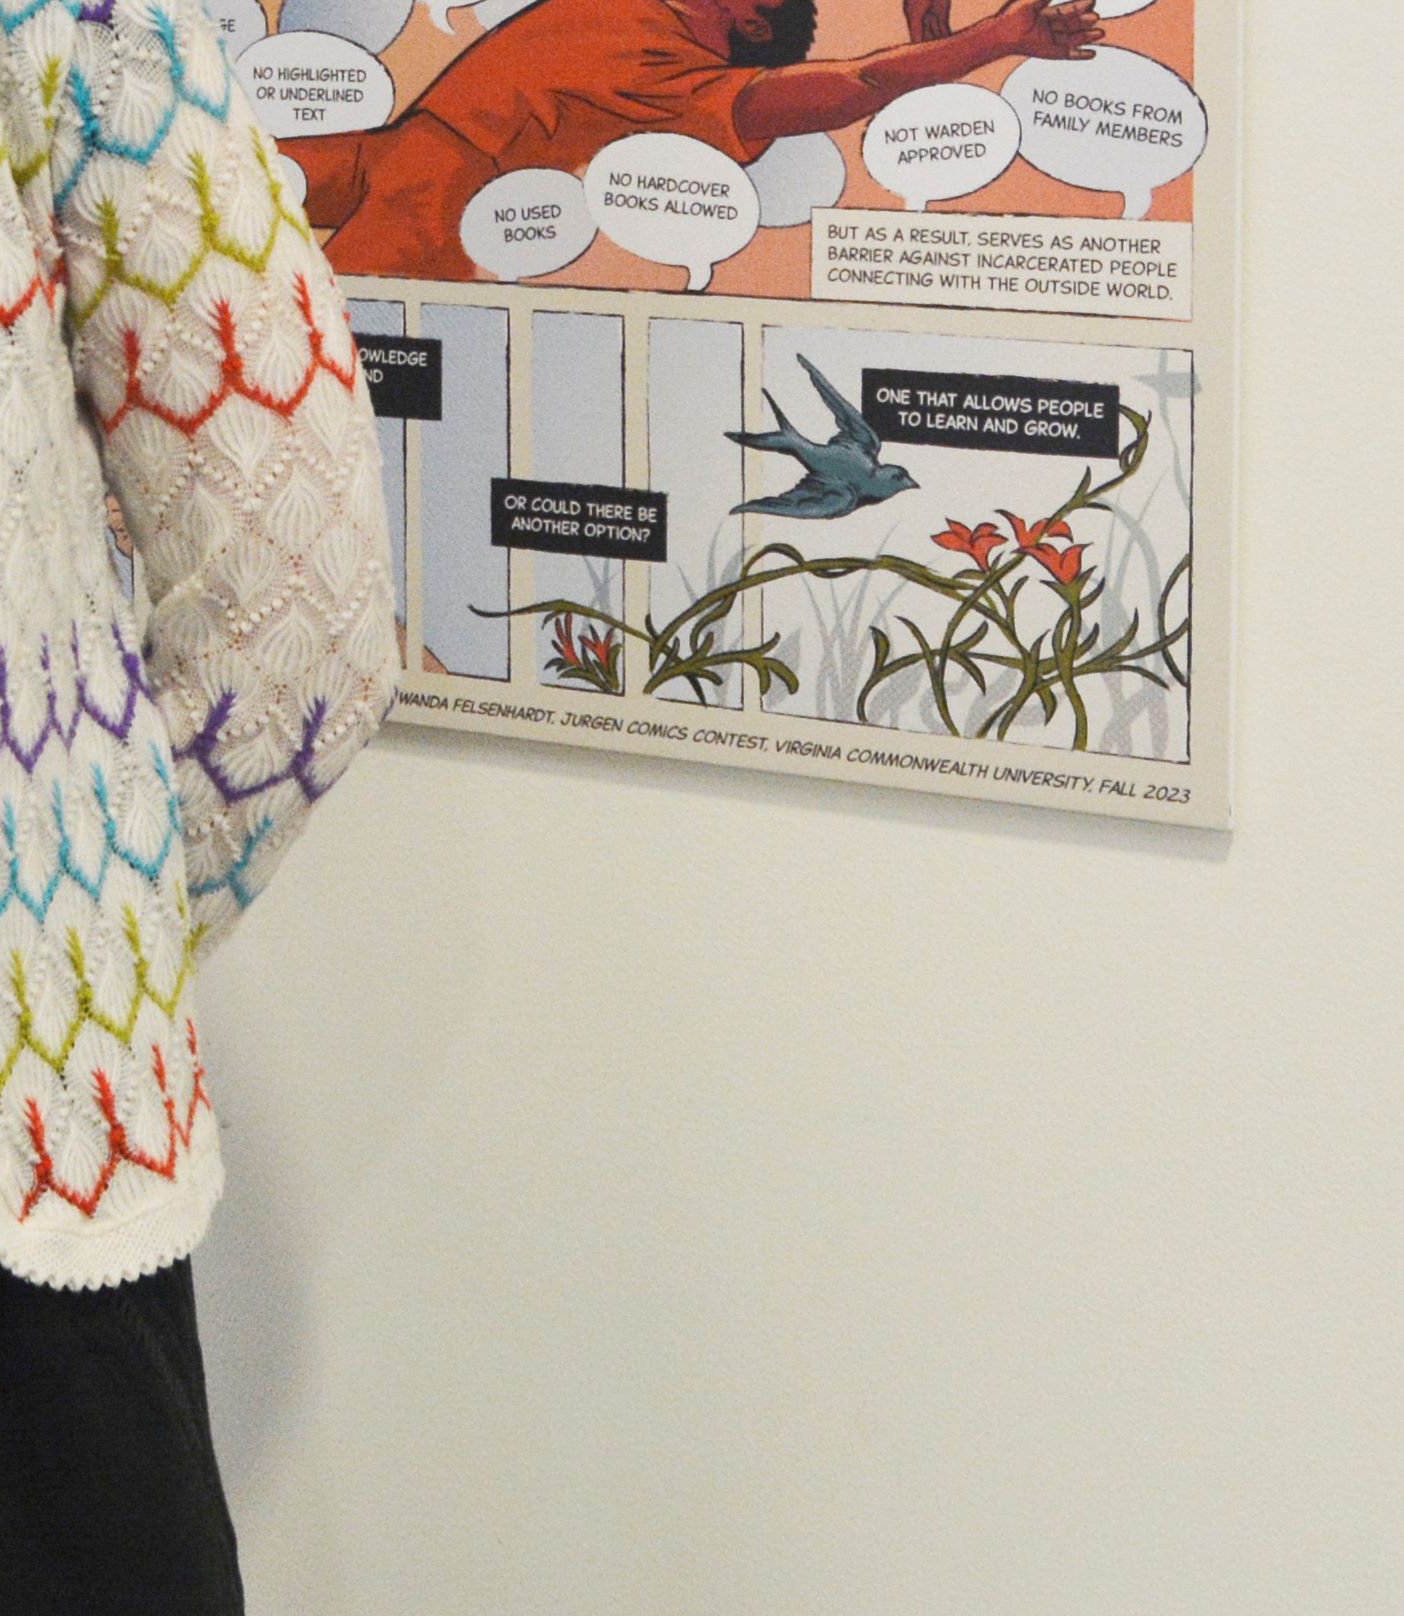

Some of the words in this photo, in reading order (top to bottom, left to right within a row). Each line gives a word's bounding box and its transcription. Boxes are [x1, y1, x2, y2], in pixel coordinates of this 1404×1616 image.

[252, 65, 274, 80] NO
[277, 66, 367, 83] HIGHLIGHTED
[255, 85, 276, 100] OR
[279, 86, 364, 103] UNDERLINED
[1031, 88, 1059, 106] NO
[1063, 91, 1127, 117] BOOKS
[1131, 102, 1183, 125] FROM
[292, 106, 326, 122] TEXT
[883, 126, 919, 144] NOT
[924, 118, 995, 140] WARDEN
[1033, 109, 1090, 133] FAMILY
[1094, 120, 1183, 148] MEMBERS
[896, 141, 987, 165] APPROVED
[608, 171, 633, 187] NO
[636, 174, 730, 198] HARDCOVER
[493, 206, 517, 224] NO
[520, 203, 562, 221] USED
[603, 190, 659, 212] BOOKS
[663, 198, 739, 221] ALLOWED
[502, 224, 557, 243] BOOKS
[875, 386, 911, 406] ONE
[916, 389, 958, 408] THAT
[962, 393, 1033, 414] ALLOWS
[1036, 397, 1105, 419] PEOPLE
[897, 410, 922, 427] TO
[926, 412, 979, 431] LEARN
[982, 416, 1019, 435] AND
[1023, 418, 1081, 439] GROW.
[503, 493, 528, 510] OR
[530, 496, 581, 516] COULD
[585, 501, 633, 521] THERE
[637, 505, 657, 524] BE
[510, 515, 580, 536] ANOTHER
[582, 521, 651, 542] OPTION?
[396, 687, 449, 711] WANDA
[559, 711, 624, 732] JURGEN
[625, 719, 689, 741] COMICS
[775, 739, 842, 760] VIRGINIA
[845, 747, 989, 779] COMMONWEALTH
[1098, 778, 1136, 798] FALL
[1142, 783, 1191, 804] 2023
